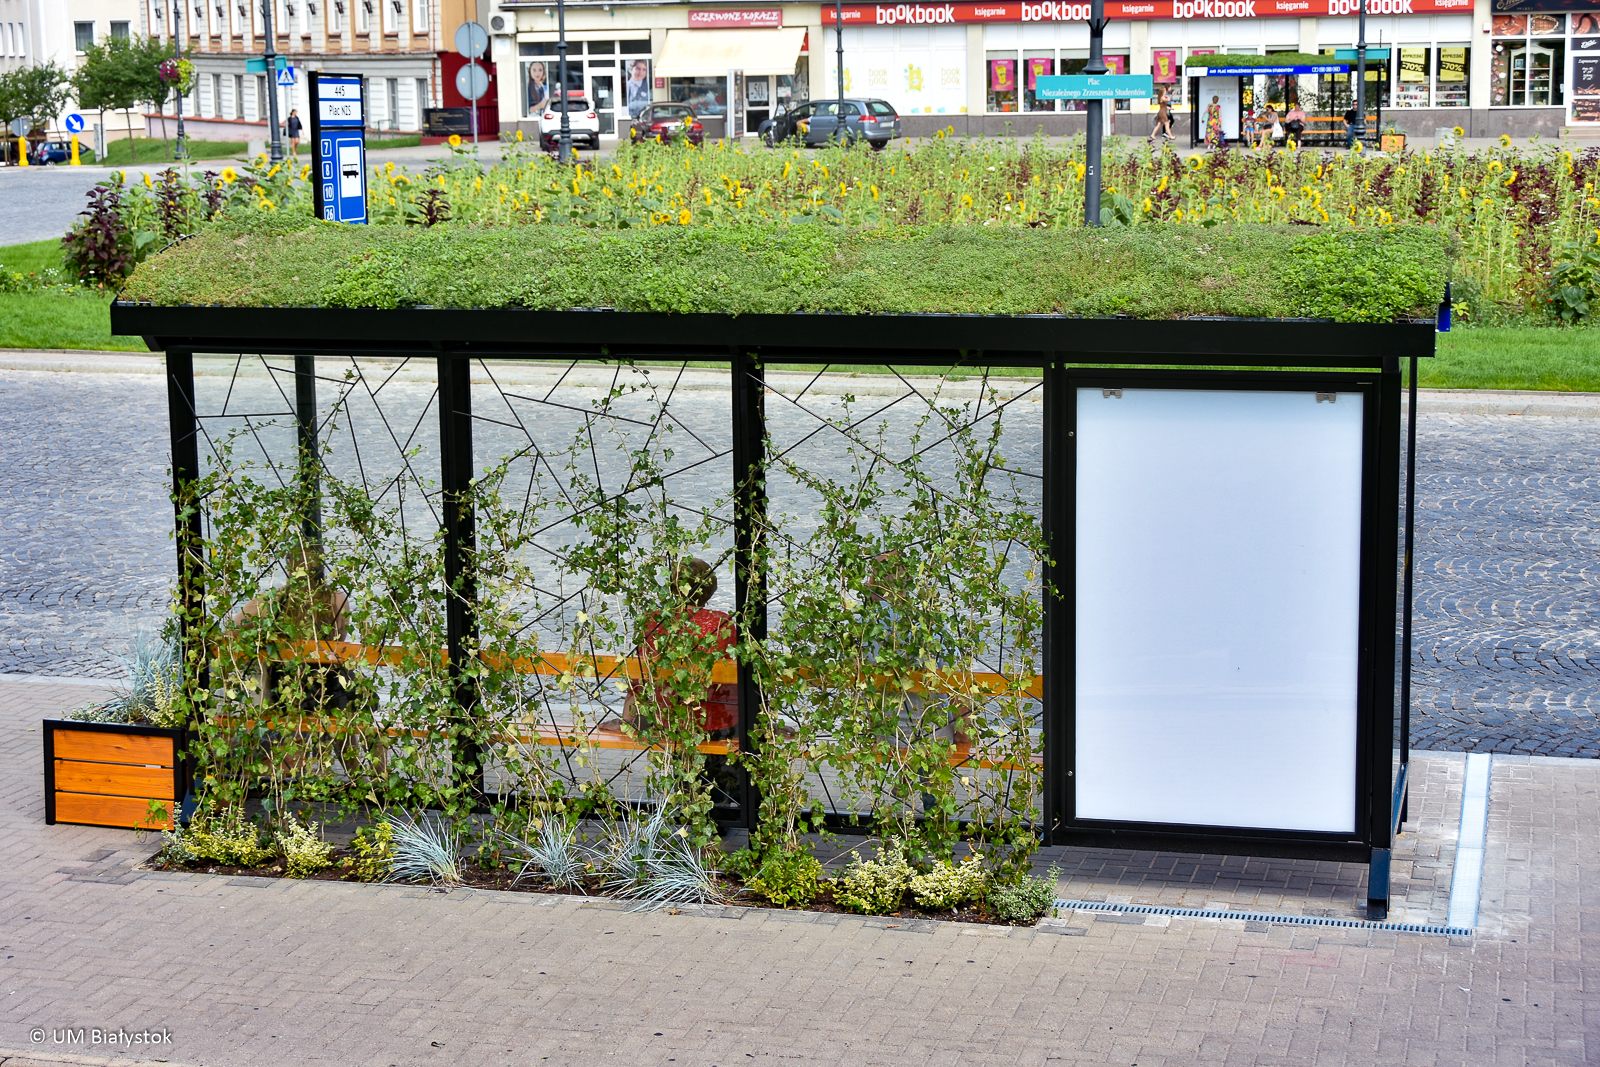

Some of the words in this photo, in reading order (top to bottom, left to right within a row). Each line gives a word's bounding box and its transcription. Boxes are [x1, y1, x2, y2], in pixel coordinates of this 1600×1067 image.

[1021, 1, 1092, 21] bookboo
[1122, 4, 1154, 14] księgarnie
[1173, 0, 1256, 18] bookbook
[1276, 1, 1309, 11] księgarnie
[691, 12, 741, 22] CZERWONE
[742, 11, 778, 21] KORALE
[876, 4, 955, 24] bookbook
[974, 7, 1006, 18] księgarnie
[868, 68, 888, 76] book
[942, 68, 960, 76] book
[1088, 78, 1100, 86] Plac
[335, 86, 345, 96] 445
[1042, 88, 1080, 98] Niezależnego
[1115, 88, 1146, 96] Studentów
[329, 105, 340, 116] Plac
[341, 105, 351, 116] NZS
[324, 142, 329, 152] 7
[325, 164, 329, 176] 8
[325, 187, 333, 198] 10
[326, 209, 333, 221] 26
